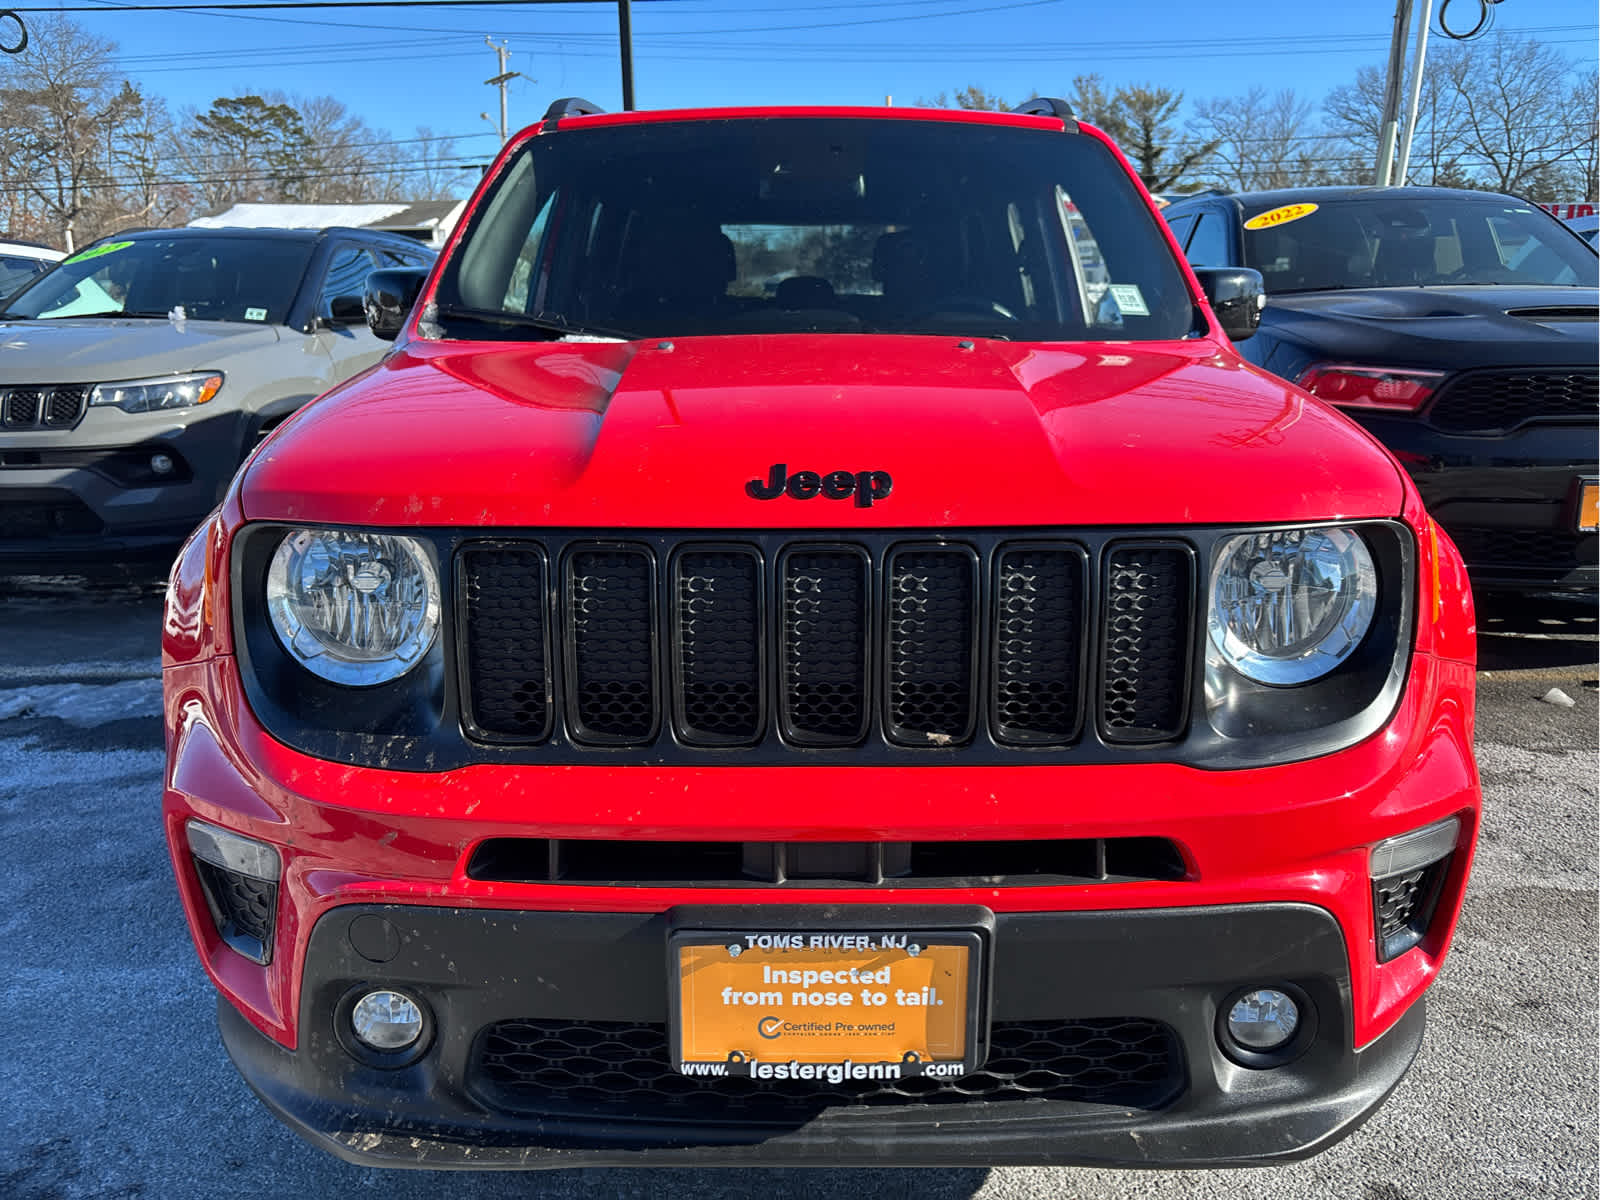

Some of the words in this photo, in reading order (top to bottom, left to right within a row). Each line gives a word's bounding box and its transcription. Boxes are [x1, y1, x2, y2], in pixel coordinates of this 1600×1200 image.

[1258, 205, 1304, 226] 2022
[746, 463, 893, 508] Jeep
[745, 934, 804, 949] TOMS
[810, 934, 877, 951] RIVER,
[881, 934, 908, 949] NJ
[763, 966, 891, 988] Inspected
[721, 987, 783, 1006] from
[792, 991, 853, 1006] nose
[860, 989, 887, 1006] to
[895, 986, 944, 1006] tail.
[783, 1022, 832, 1032] Certified
[680, 1062, 729, 1076] www.
[750, 1059, 901, 1084] lesterglenn
[920, 1061, 965, 1076] .com
